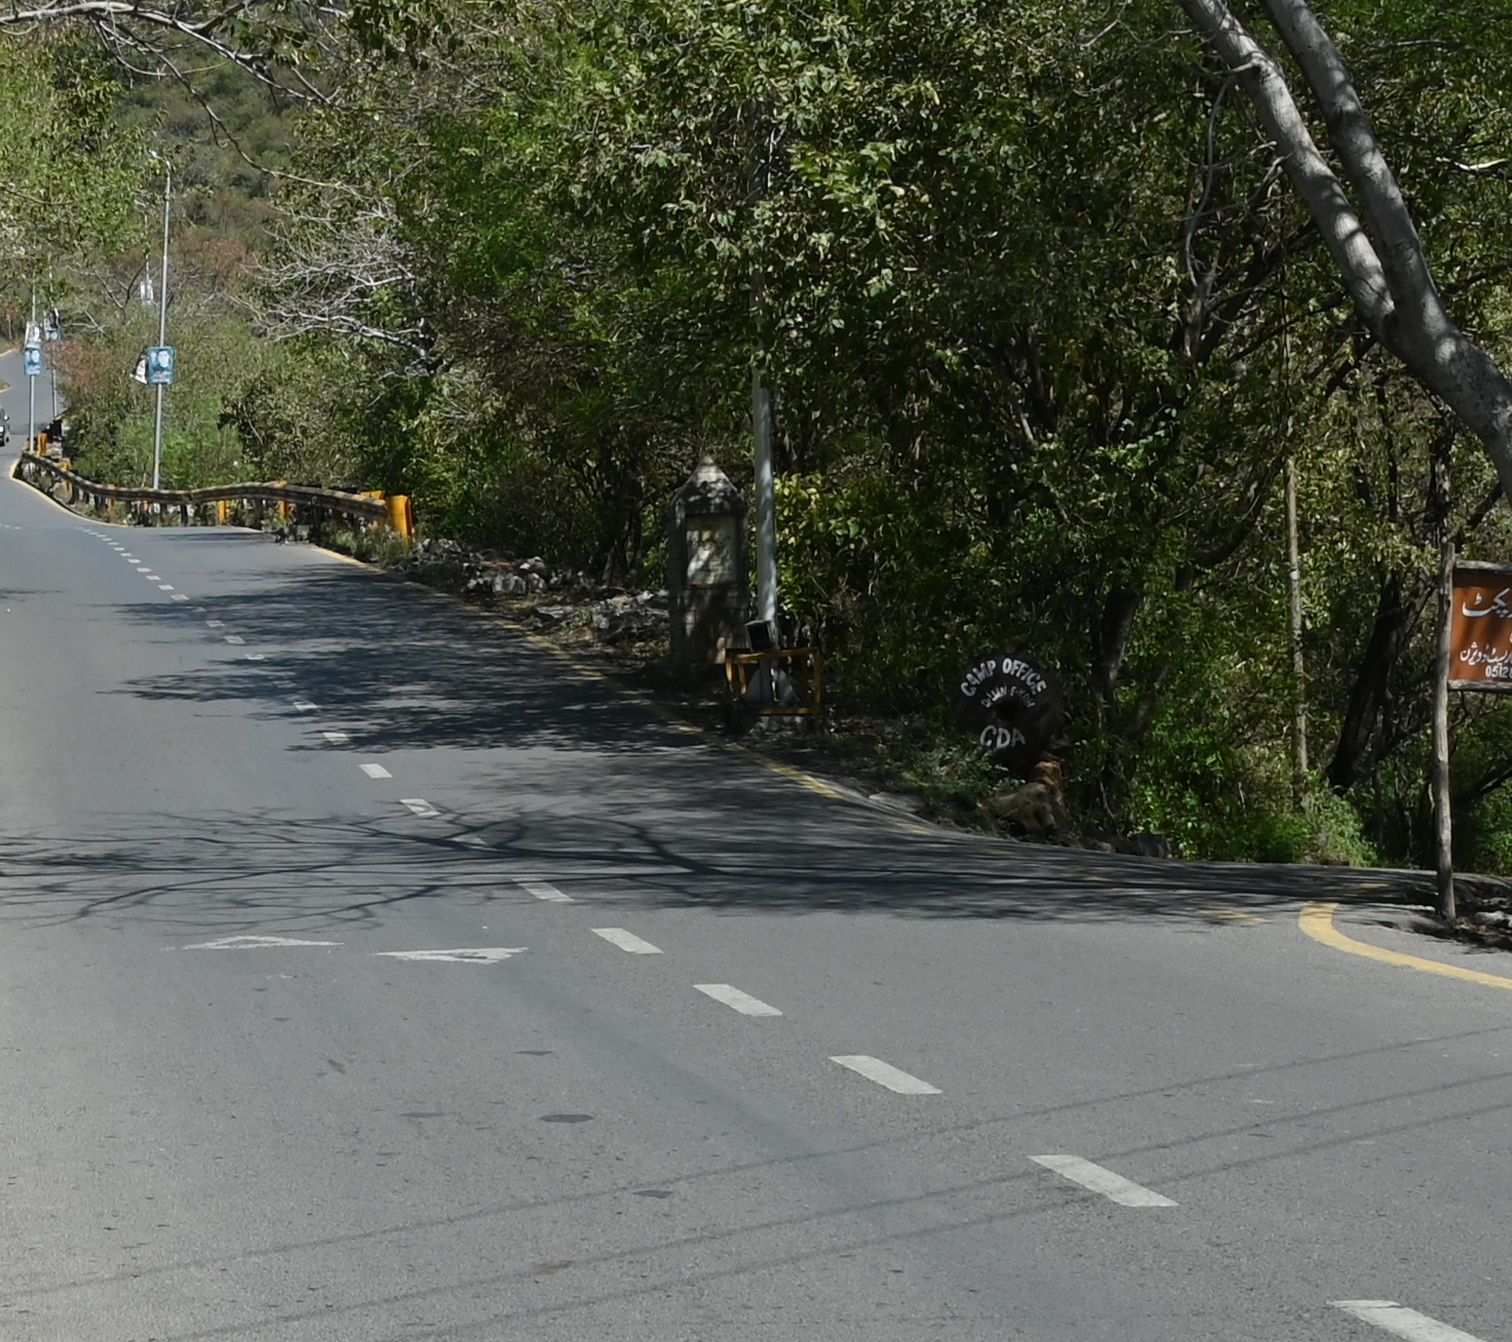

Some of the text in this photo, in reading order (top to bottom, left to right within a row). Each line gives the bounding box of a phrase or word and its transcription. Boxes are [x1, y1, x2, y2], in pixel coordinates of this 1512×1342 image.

[960, 657, 1047, 697] CAMP OFFICE
[979, 724, 1026, 750] CDA
